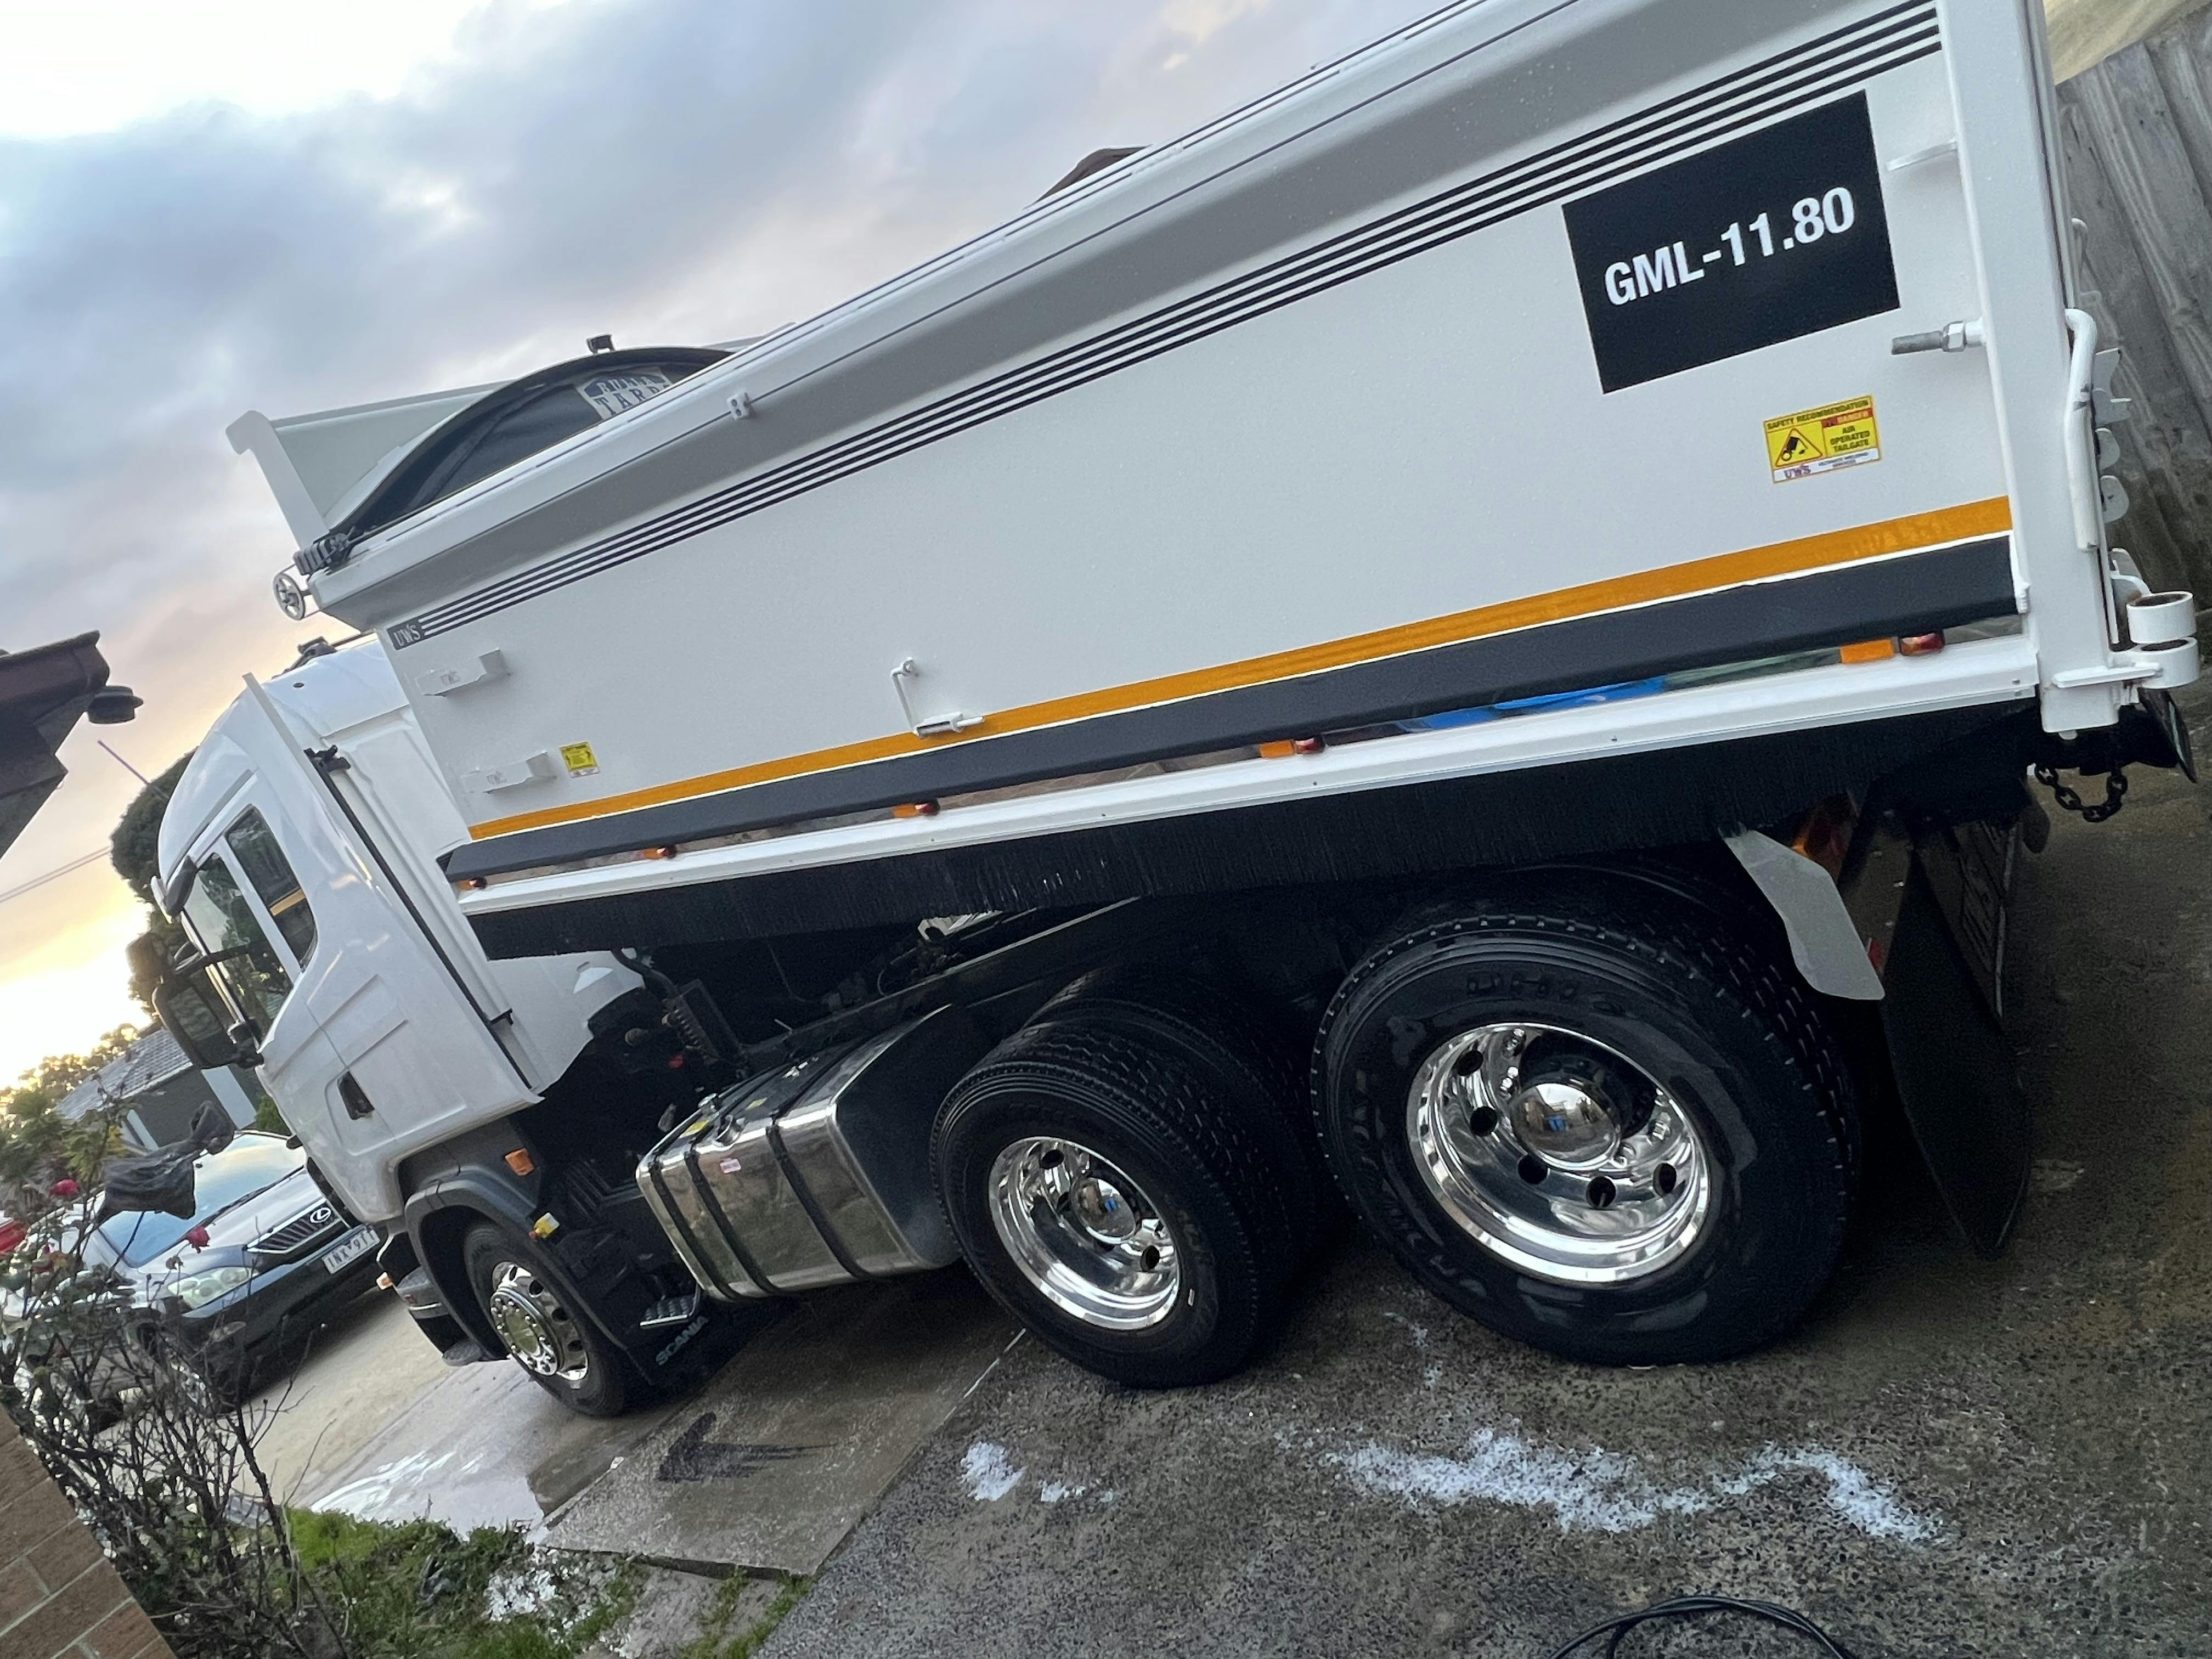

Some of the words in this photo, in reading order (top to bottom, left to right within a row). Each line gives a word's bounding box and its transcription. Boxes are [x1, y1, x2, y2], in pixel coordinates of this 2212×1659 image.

[1604, 187, 1855, 306] GML-11.80
[1767, 417, 1794, 430] SAFETY
[1843, 426, 1855, 434] AIR
[1830, 431, 1870, 445] OPERATED
[1833, 439, 1869, 452] TAILGATE
[656, 1316, 709, 1365] SCANIA
